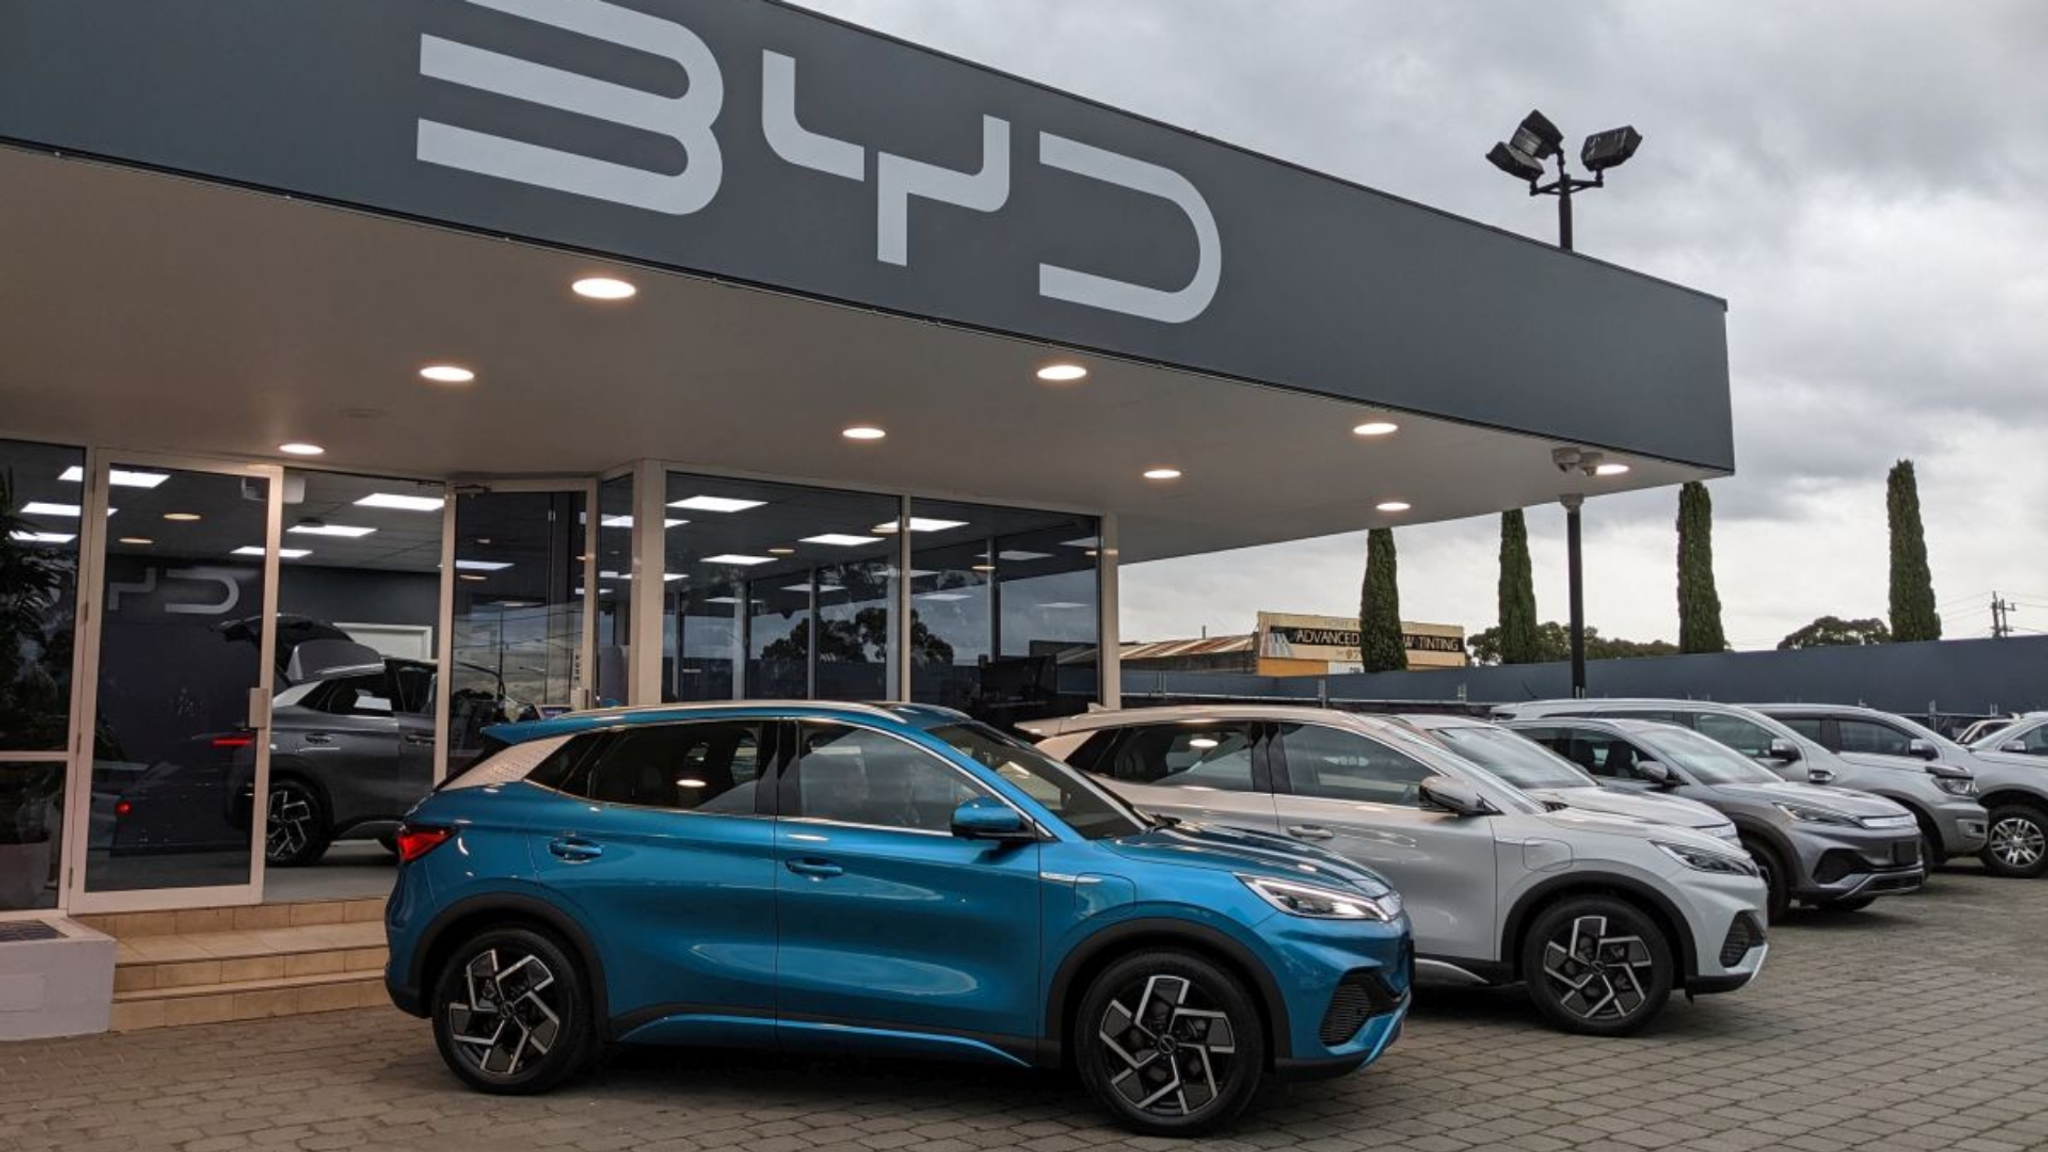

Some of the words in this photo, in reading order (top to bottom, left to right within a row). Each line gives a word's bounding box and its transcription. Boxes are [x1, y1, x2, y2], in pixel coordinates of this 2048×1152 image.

[416, 0, 1222, 325] BYD
[1295, 629, 1360, 645] ADVANCED
[1418, 635, 1459, 651] TINTING
